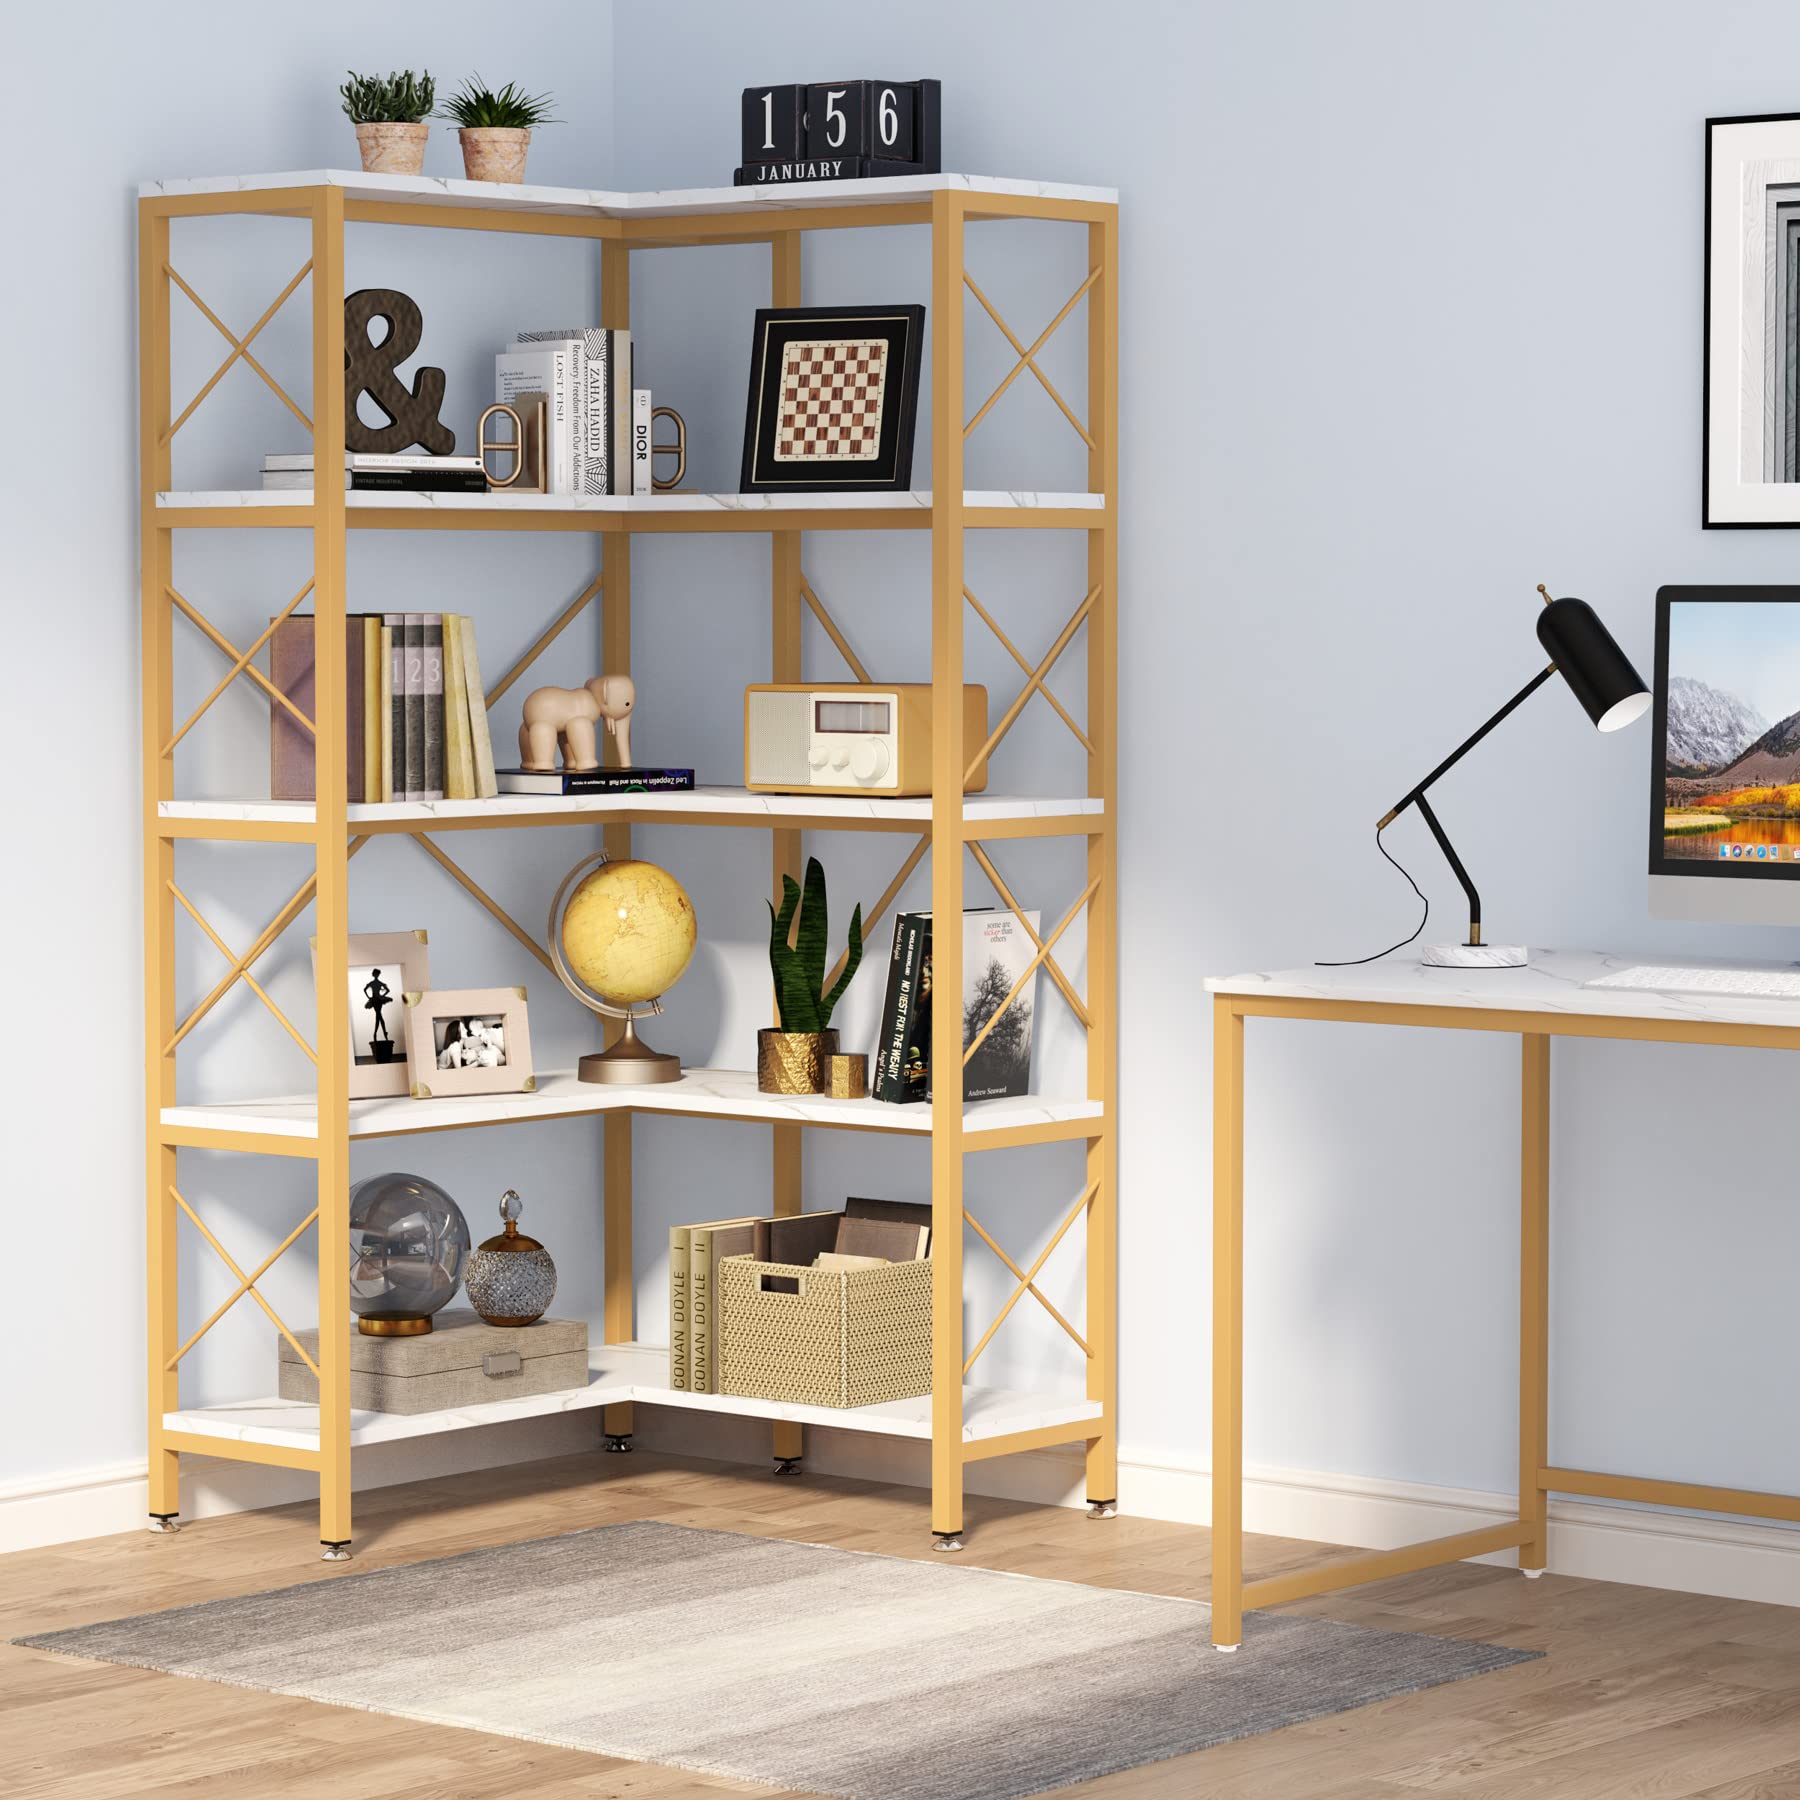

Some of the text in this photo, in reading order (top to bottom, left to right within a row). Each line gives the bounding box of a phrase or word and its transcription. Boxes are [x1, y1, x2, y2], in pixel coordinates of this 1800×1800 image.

[761, 88, 898, 149] 1 5 6
[757, 160, 843, 181] JANUARY
[556, 355, 564, 422] LOST FISH
[572, 382, 581, 414] Freedom
[572, 415, 581, 434] From
[590, 368, 600, 452] ZAHA HADID
[572, 436, 581, 451] Our
[636, 425, 647, 460] DIOR
[572, 452, 581, 491] Addictions
[410, 658, 421, 682] 2
[429, 658, 440, 682] 3
[649, 777, 675, 786] Zeppelin
[900, 980, 911, 993] NO
[898, 993, 909, 1015] REST
[896, 1015, 906, 1032] FOR
[893, 1033, 904, 1050] THE
[888, 1049, 902, 1081] WEARY
[674, 1272, 685, 1322] DOYLE
[695, 1243, 706, 1391] CONAN DOYLE II
[674, 1331, 685, 1389] CONAN
